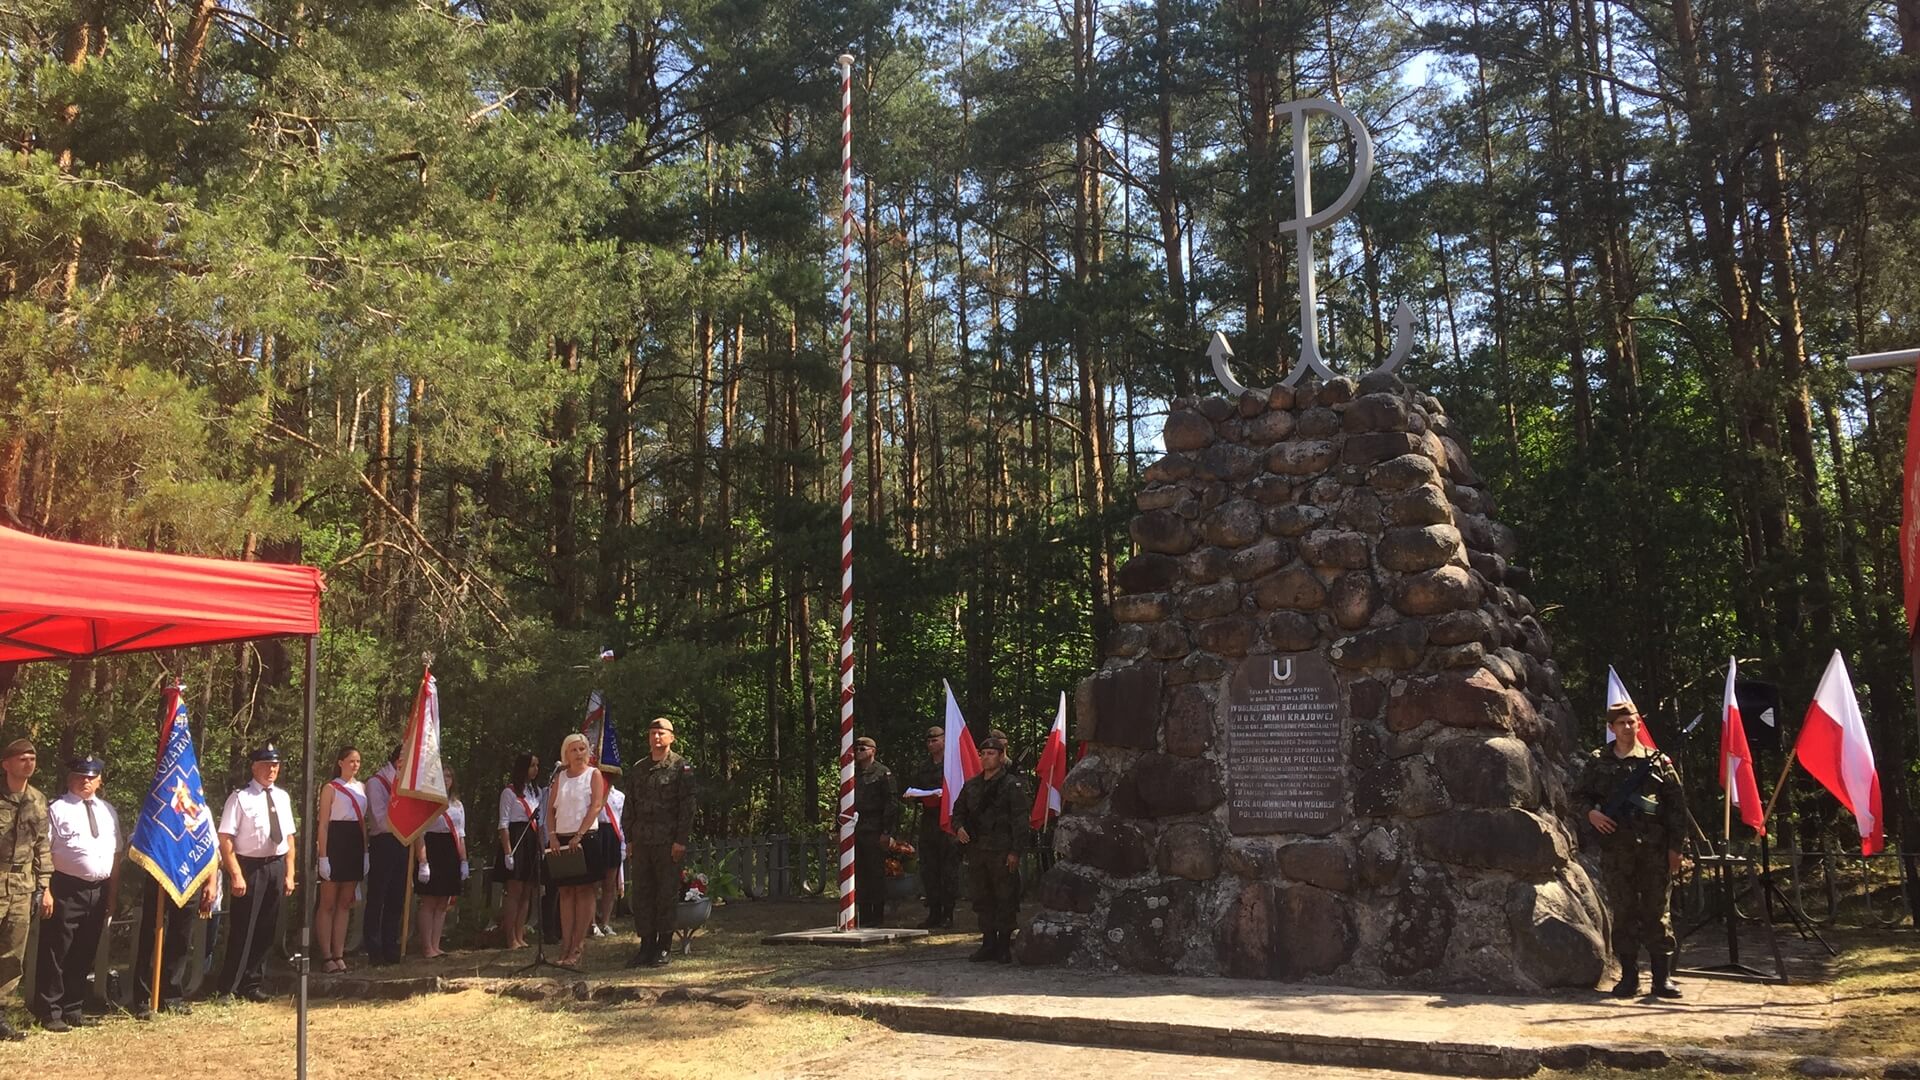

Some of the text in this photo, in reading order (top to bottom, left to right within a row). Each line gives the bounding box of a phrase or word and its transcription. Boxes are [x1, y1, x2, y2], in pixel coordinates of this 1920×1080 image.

[1262, 713, 1285, 721] ARMII
[1287, 712, 1334, 721] KRAJOWEJ
[178, 861, 191, 876] W
